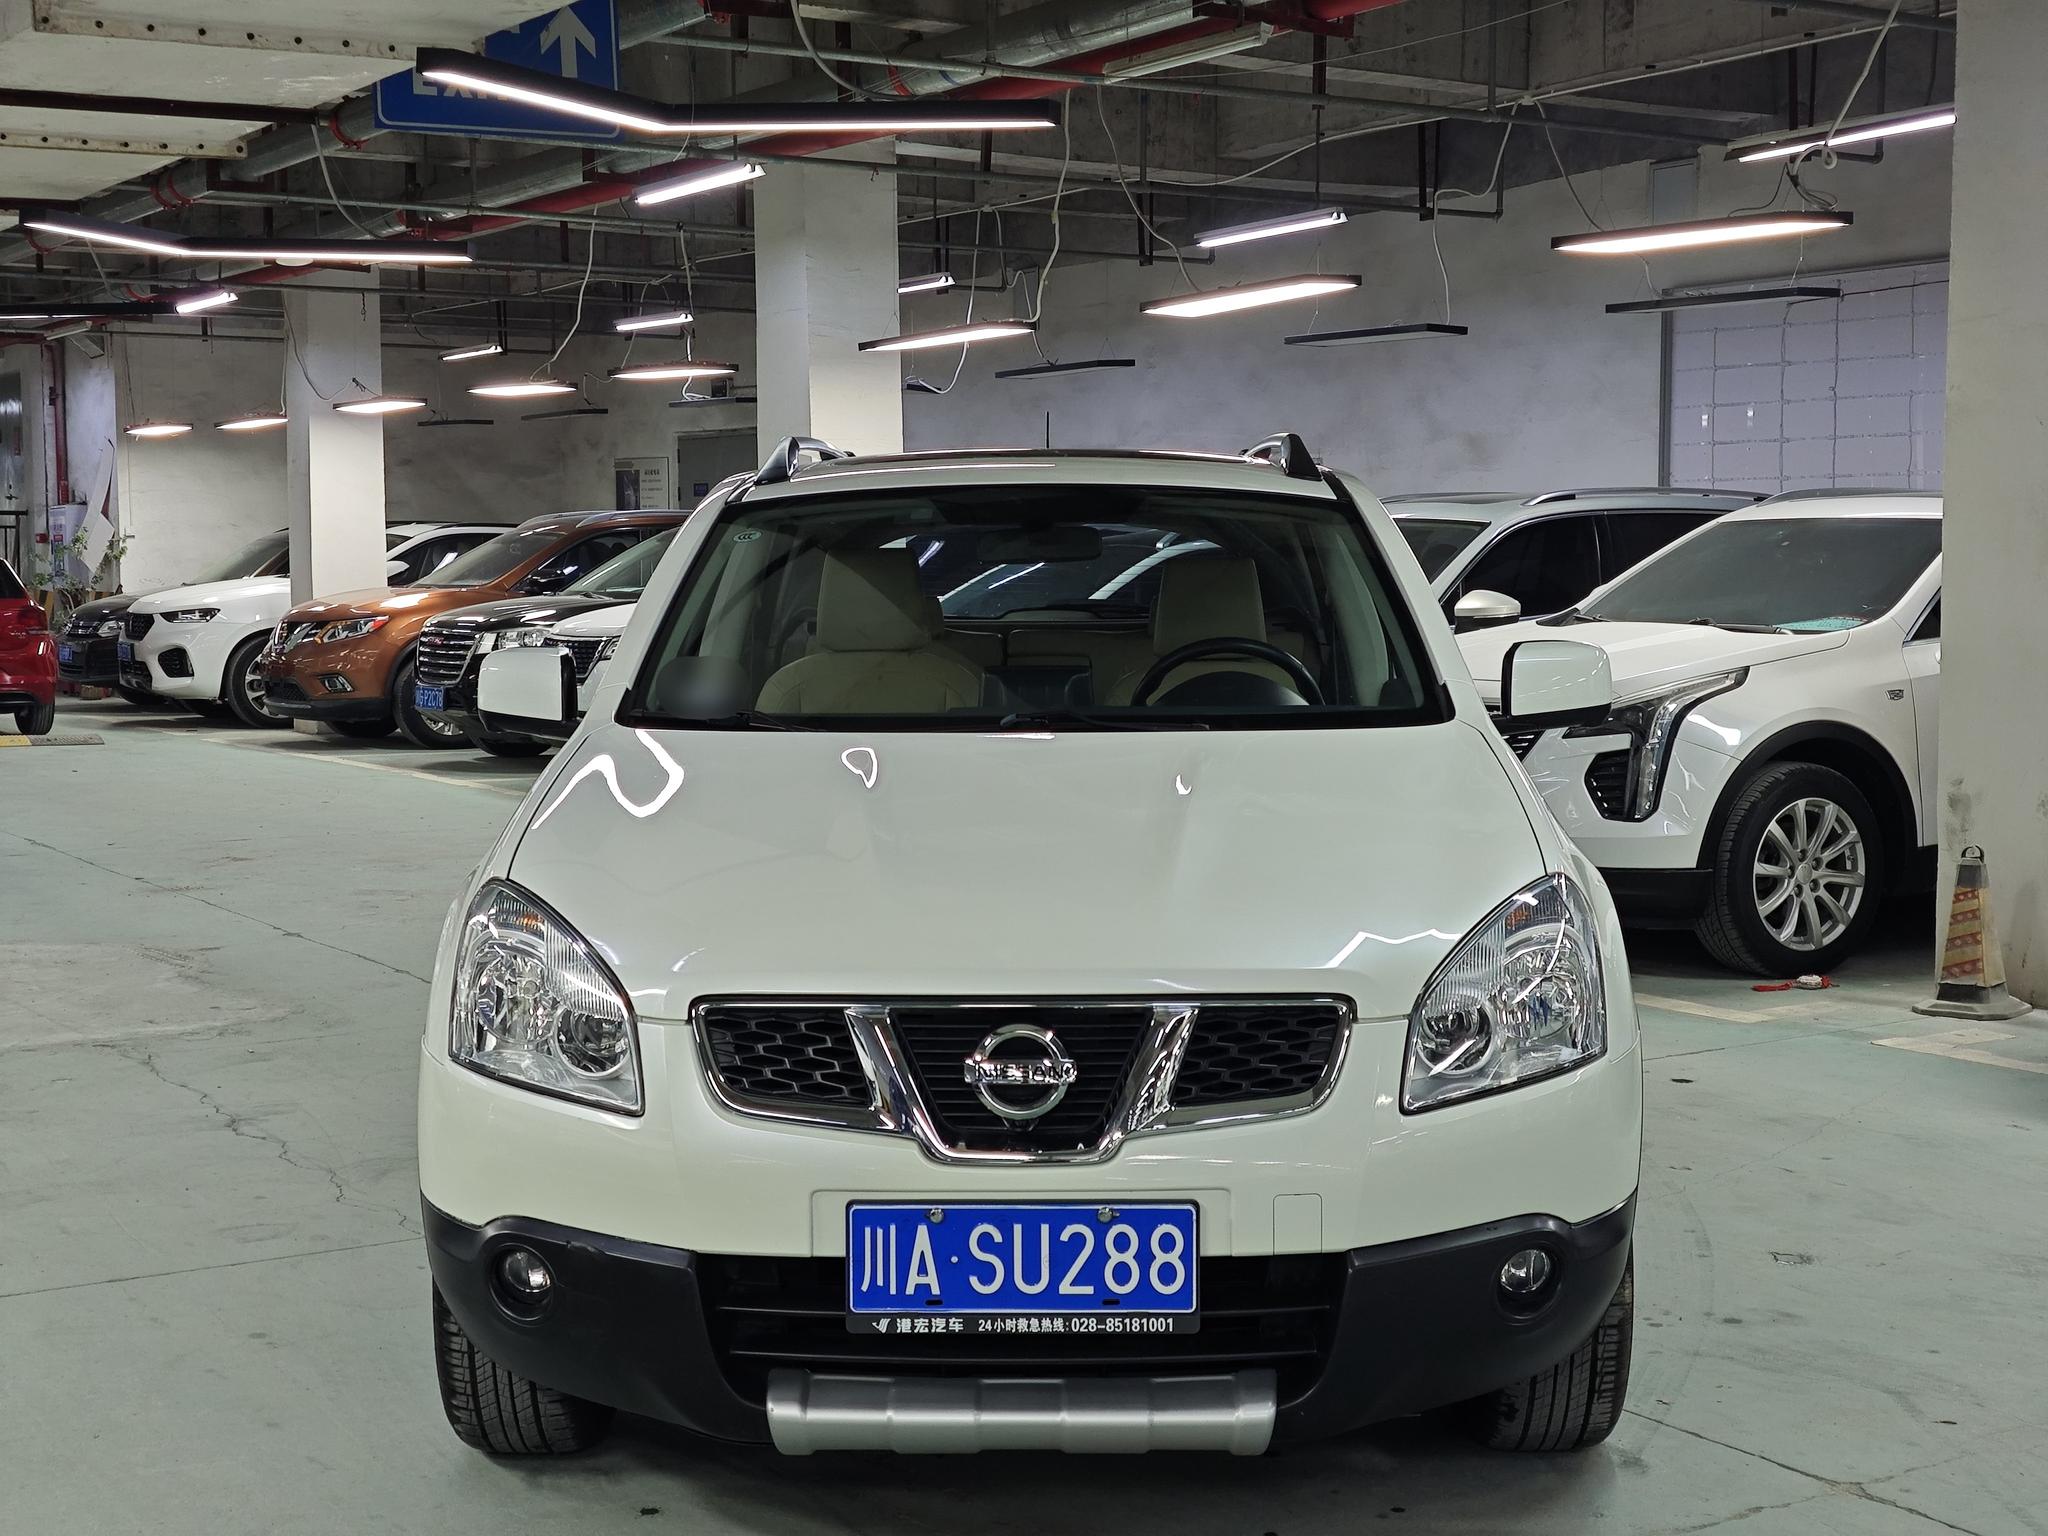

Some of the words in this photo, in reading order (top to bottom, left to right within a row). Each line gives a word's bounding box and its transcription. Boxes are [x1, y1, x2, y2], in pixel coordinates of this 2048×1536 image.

[416, 689, 442, 707] GP2C78
[861, 1223, 1186, 1296] 川A·SU288
[896, 1317, 964, 1333] 港宏汽车
